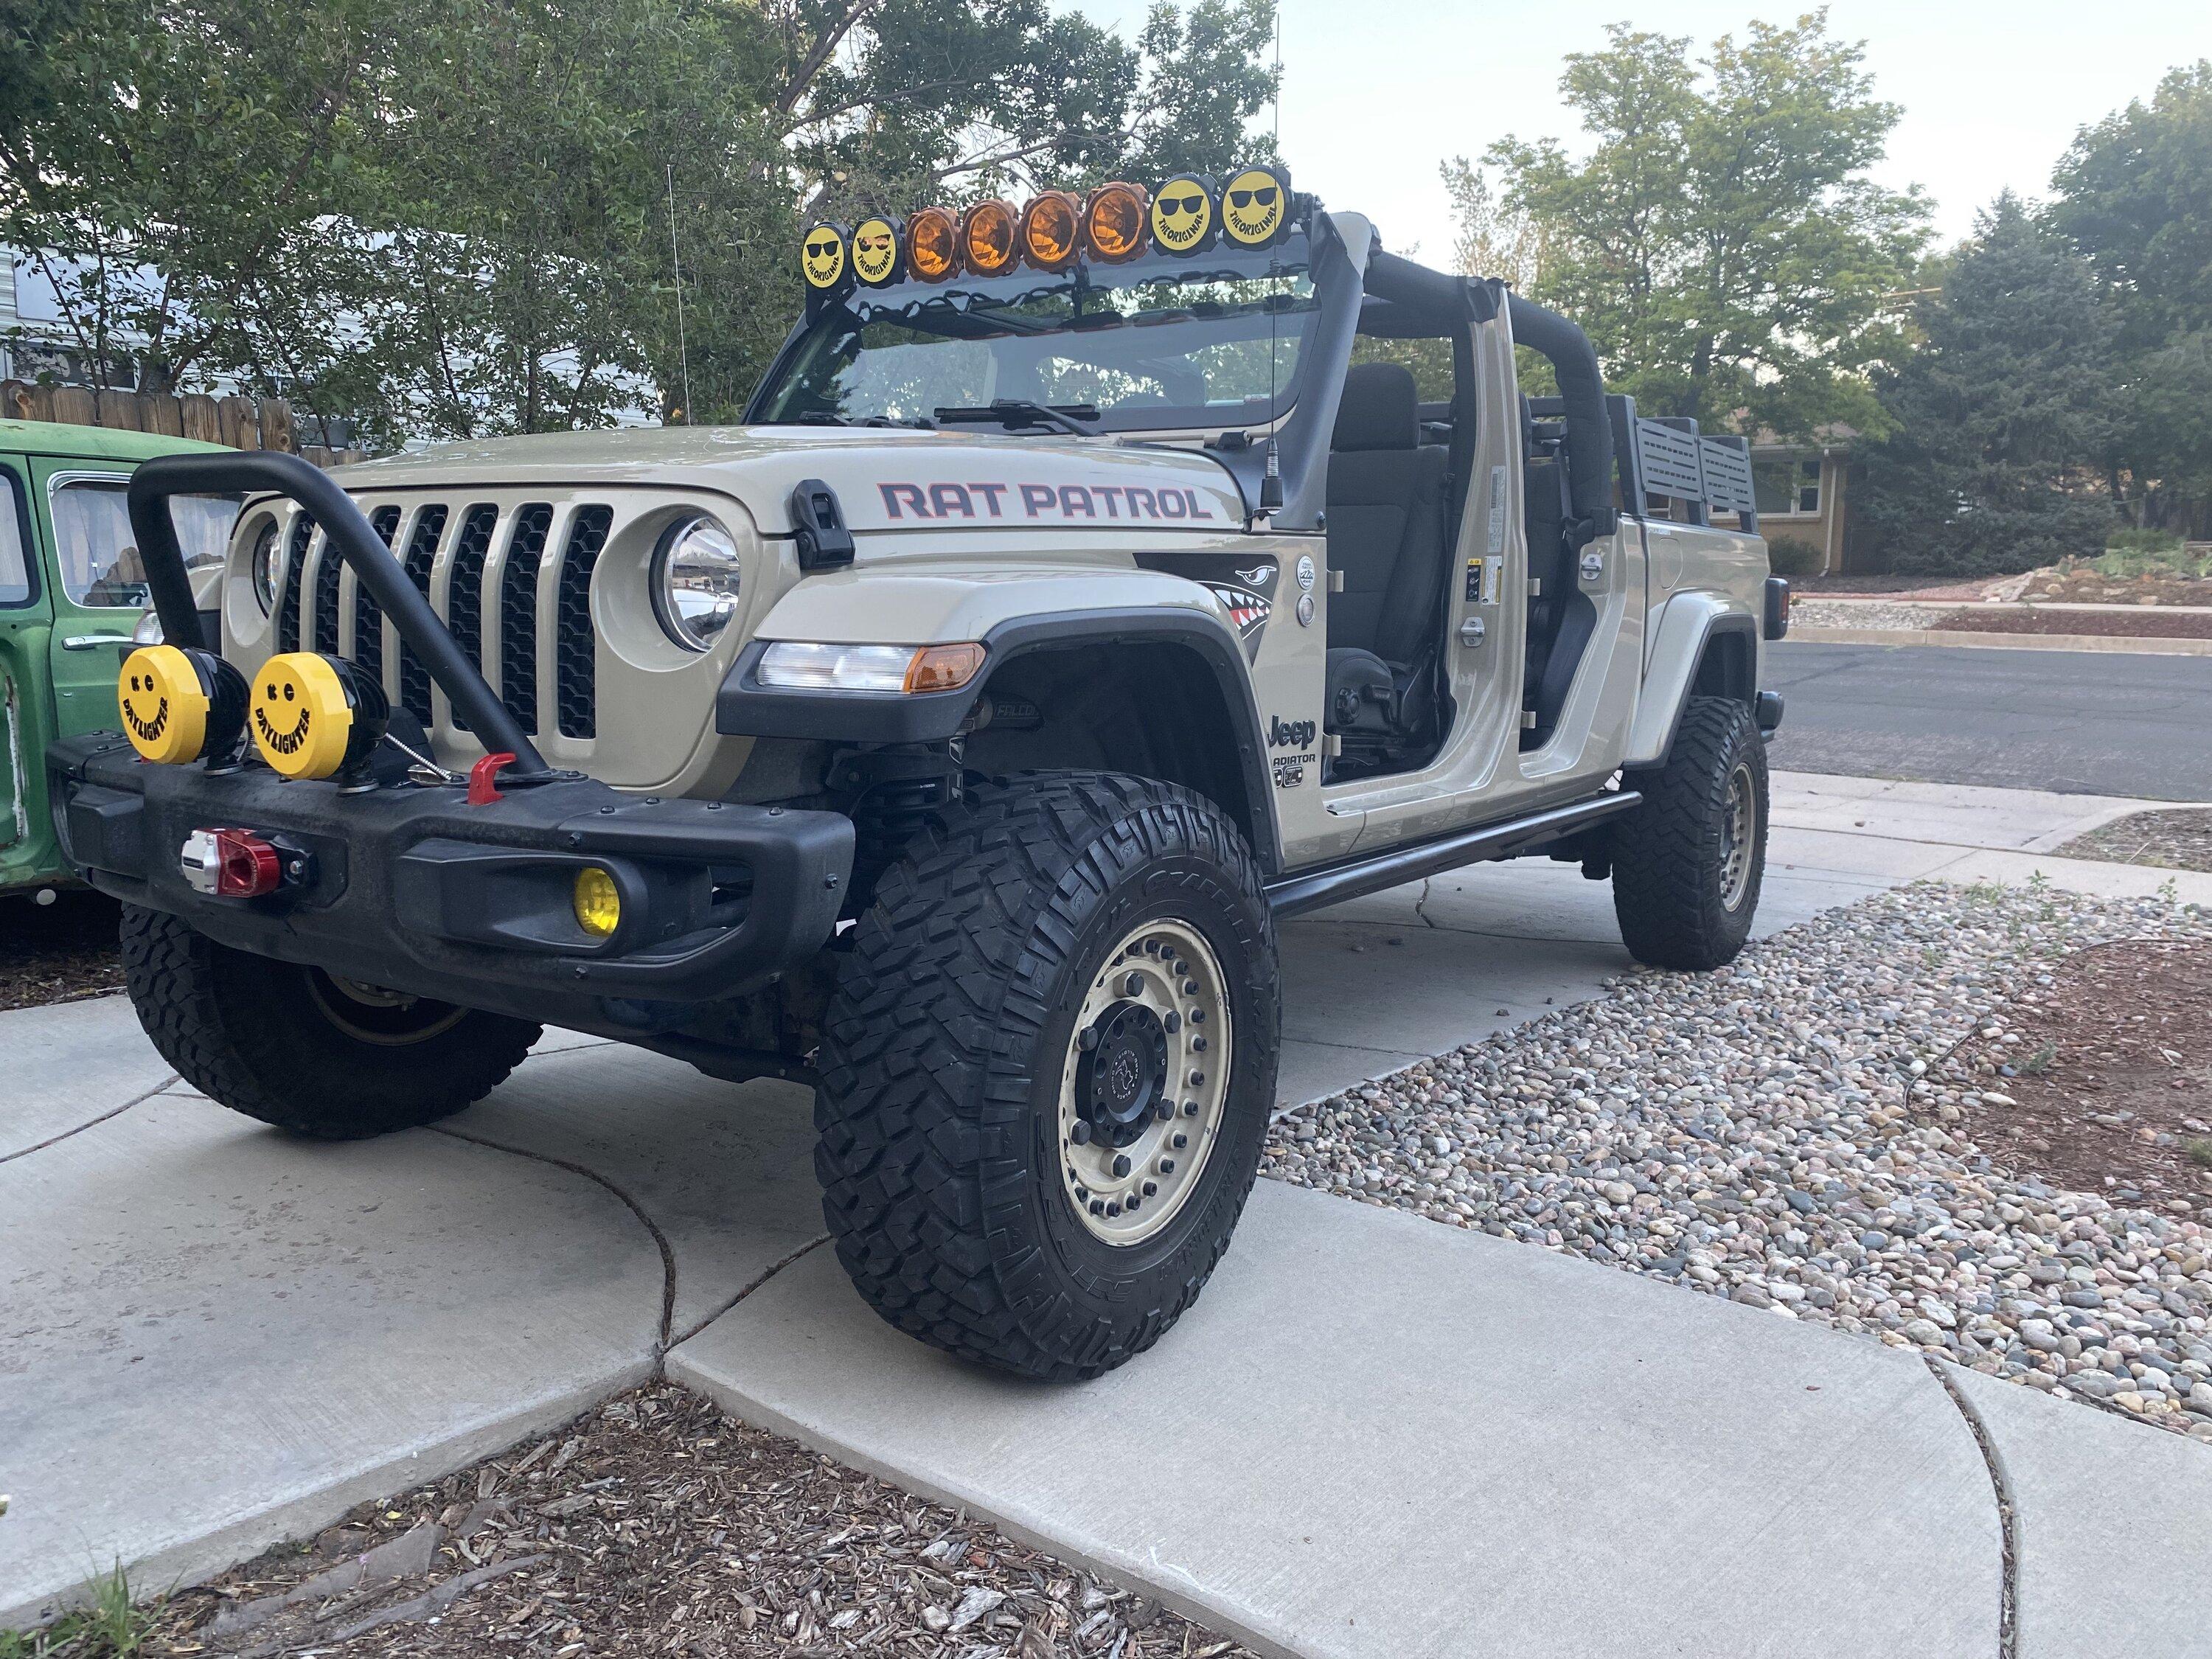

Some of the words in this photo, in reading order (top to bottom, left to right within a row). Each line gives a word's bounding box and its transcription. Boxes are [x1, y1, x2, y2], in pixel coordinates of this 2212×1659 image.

[877, 482, 1007, 519] RAT
[1018, 484, 1214, 520] PATROL
[122, 696, 169, 742] DAYLIGHTER
[255, 707, 310, 754] DAYLIGHTER
[1267, 714, 1316, 751] Jeep
[1273, 754, 1315, 766] ADIATOR
